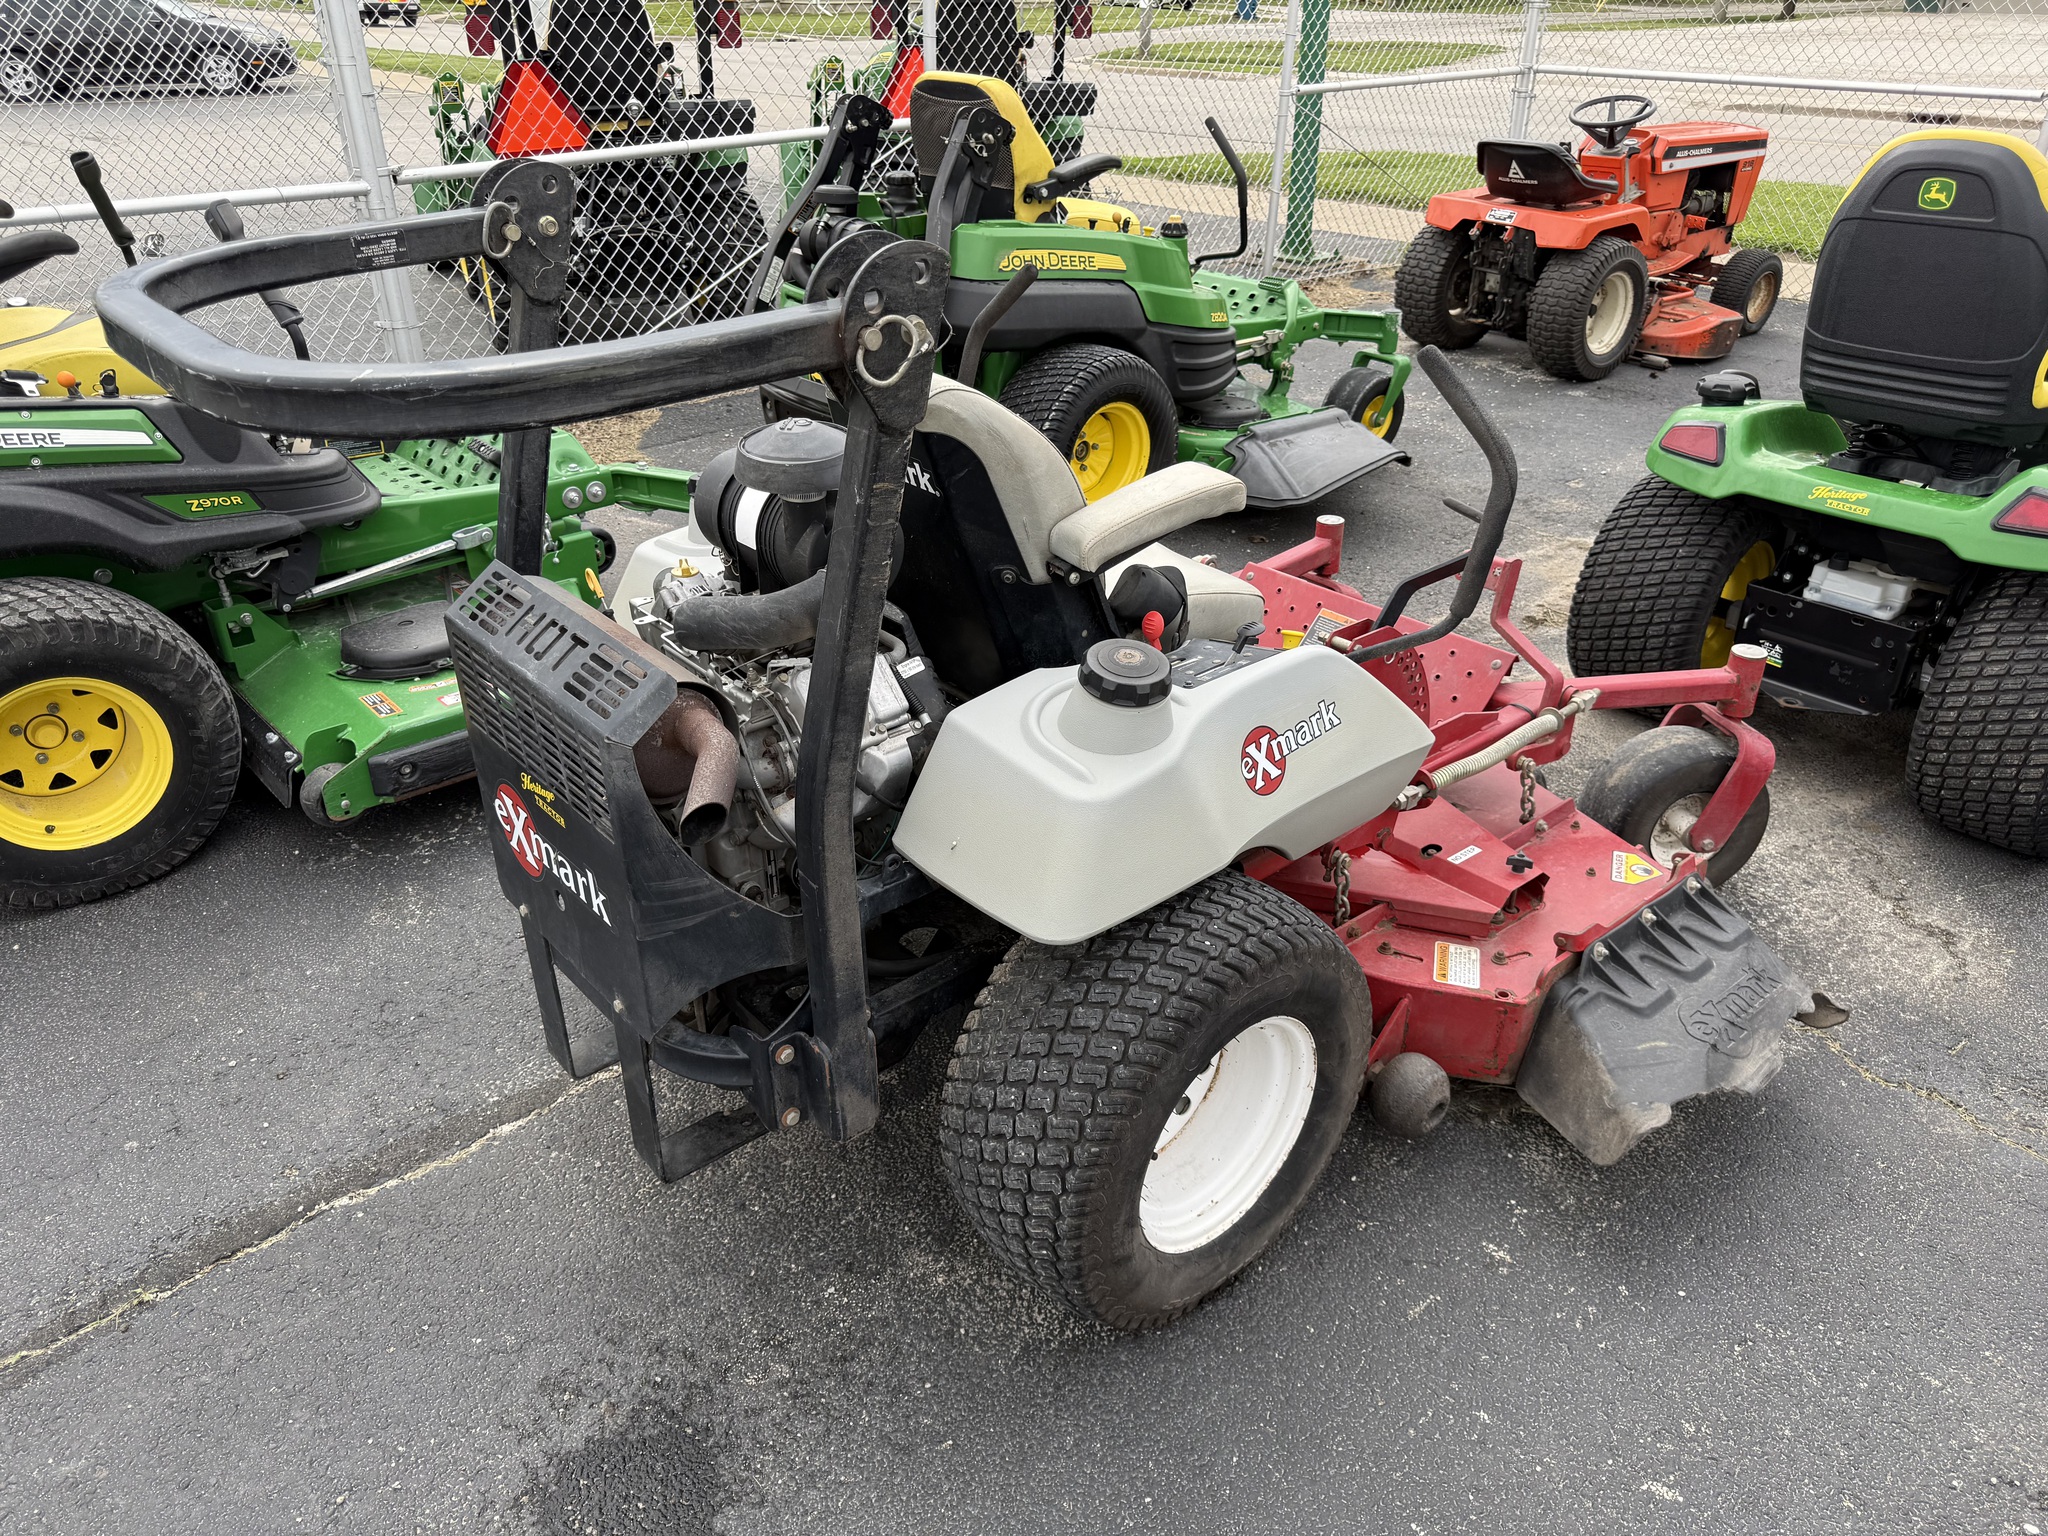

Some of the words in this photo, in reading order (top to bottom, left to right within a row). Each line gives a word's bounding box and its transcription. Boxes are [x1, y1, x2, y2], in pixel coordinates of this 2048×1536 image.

[1676, 147, 1713, 158] ALLIS-CHALMERS
[1002, 254, 1046, 269] JOHN
[1047, 251, 1097, 268] DEERE
[0, 432, 65, 446] EERE
[186, 495, 244, 512] Z970R
[1808, 485, 1868, 502] Heritage
[1825, 499, 1871, 516] TRACTOR
[504, 603, 590, 672] HOT
[1241, 699, 1342, 791] eXmark
[520, 772, 556, 802] Heritage
[534, 795, 566, 829] TRACTOR
[494, 790, 613, 928] eXmark
[1614, 853, 1624, 880] DANGER
[1439, 945, 1448, 972] WARNING
